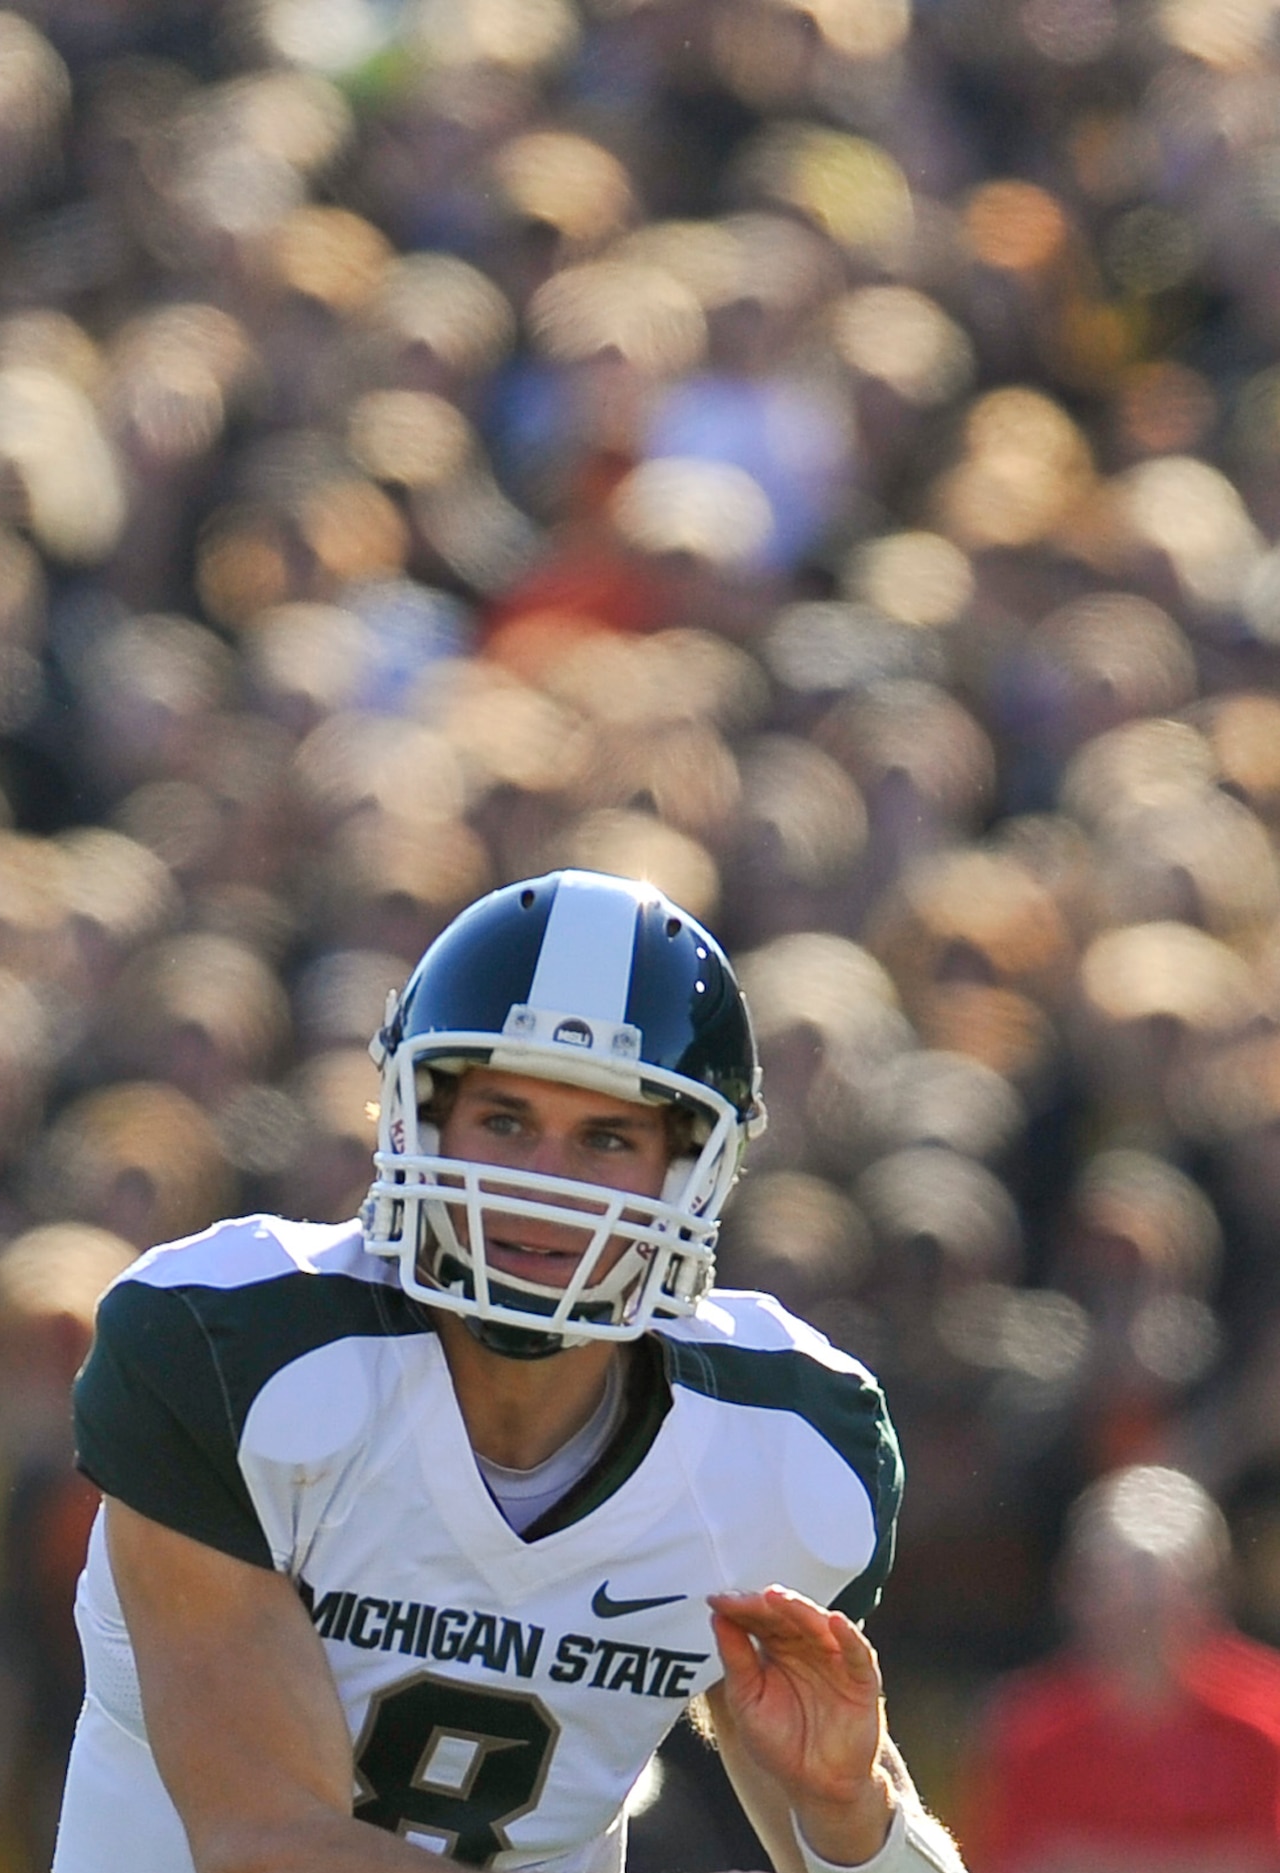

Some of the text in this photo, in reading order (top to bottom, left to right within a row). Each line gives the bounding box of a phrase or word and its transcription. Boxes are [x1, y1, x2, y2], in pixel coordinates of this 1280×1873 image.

[299, 1574, 711, 1698] MICHIGAN STATE
[353, 1670, 561, 1869] 8
